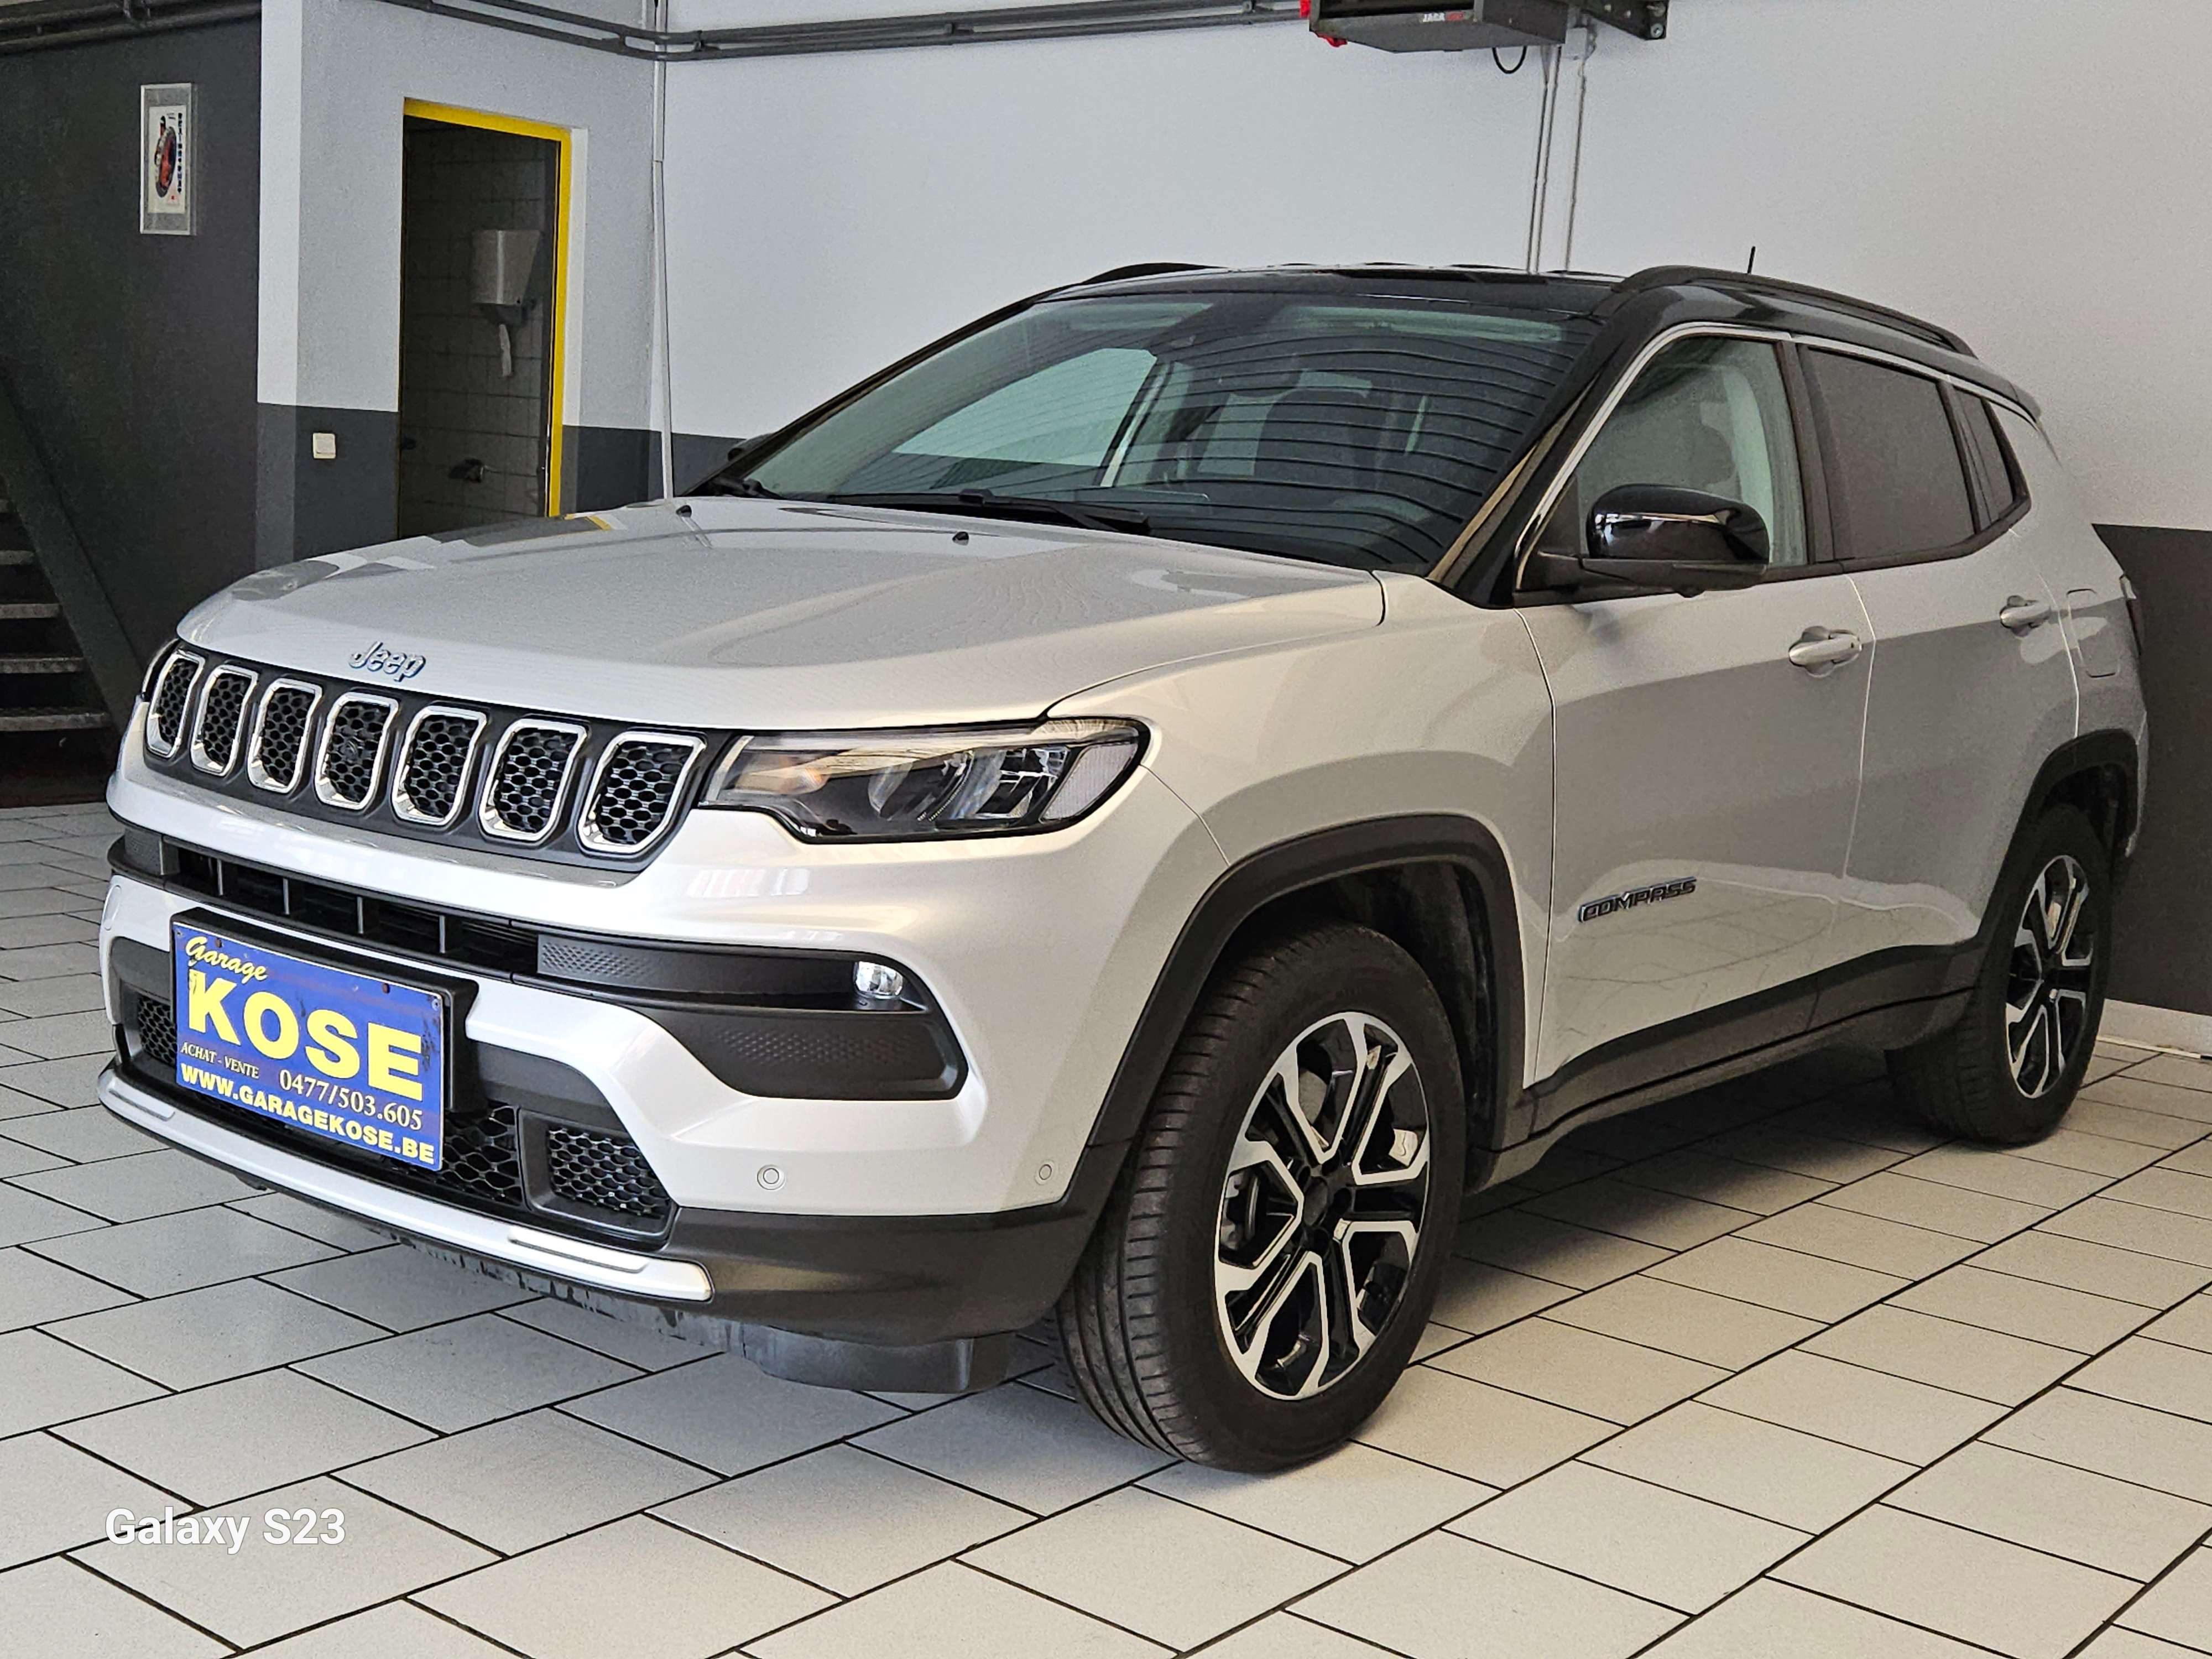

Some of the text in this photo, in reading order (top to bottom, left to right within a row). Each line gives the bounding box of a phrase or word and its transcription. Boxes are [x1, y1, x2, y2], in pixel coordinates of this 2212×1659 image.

[349, 641, 426, 682] Jeep
[1578, 876, 1697, 922] COMPASS
[185, 936, 268, 984] Garage
[189, 969, 422, 1102] KOSE
[181, 1042, 217, 1063] ACHAT
[224, 1056, 259, 1079] VENTE
[181, 1063, 435, 1165] WWW.GARAGEKOSE.BE
[279, 1069, 422, 1130] 0477/503.605
